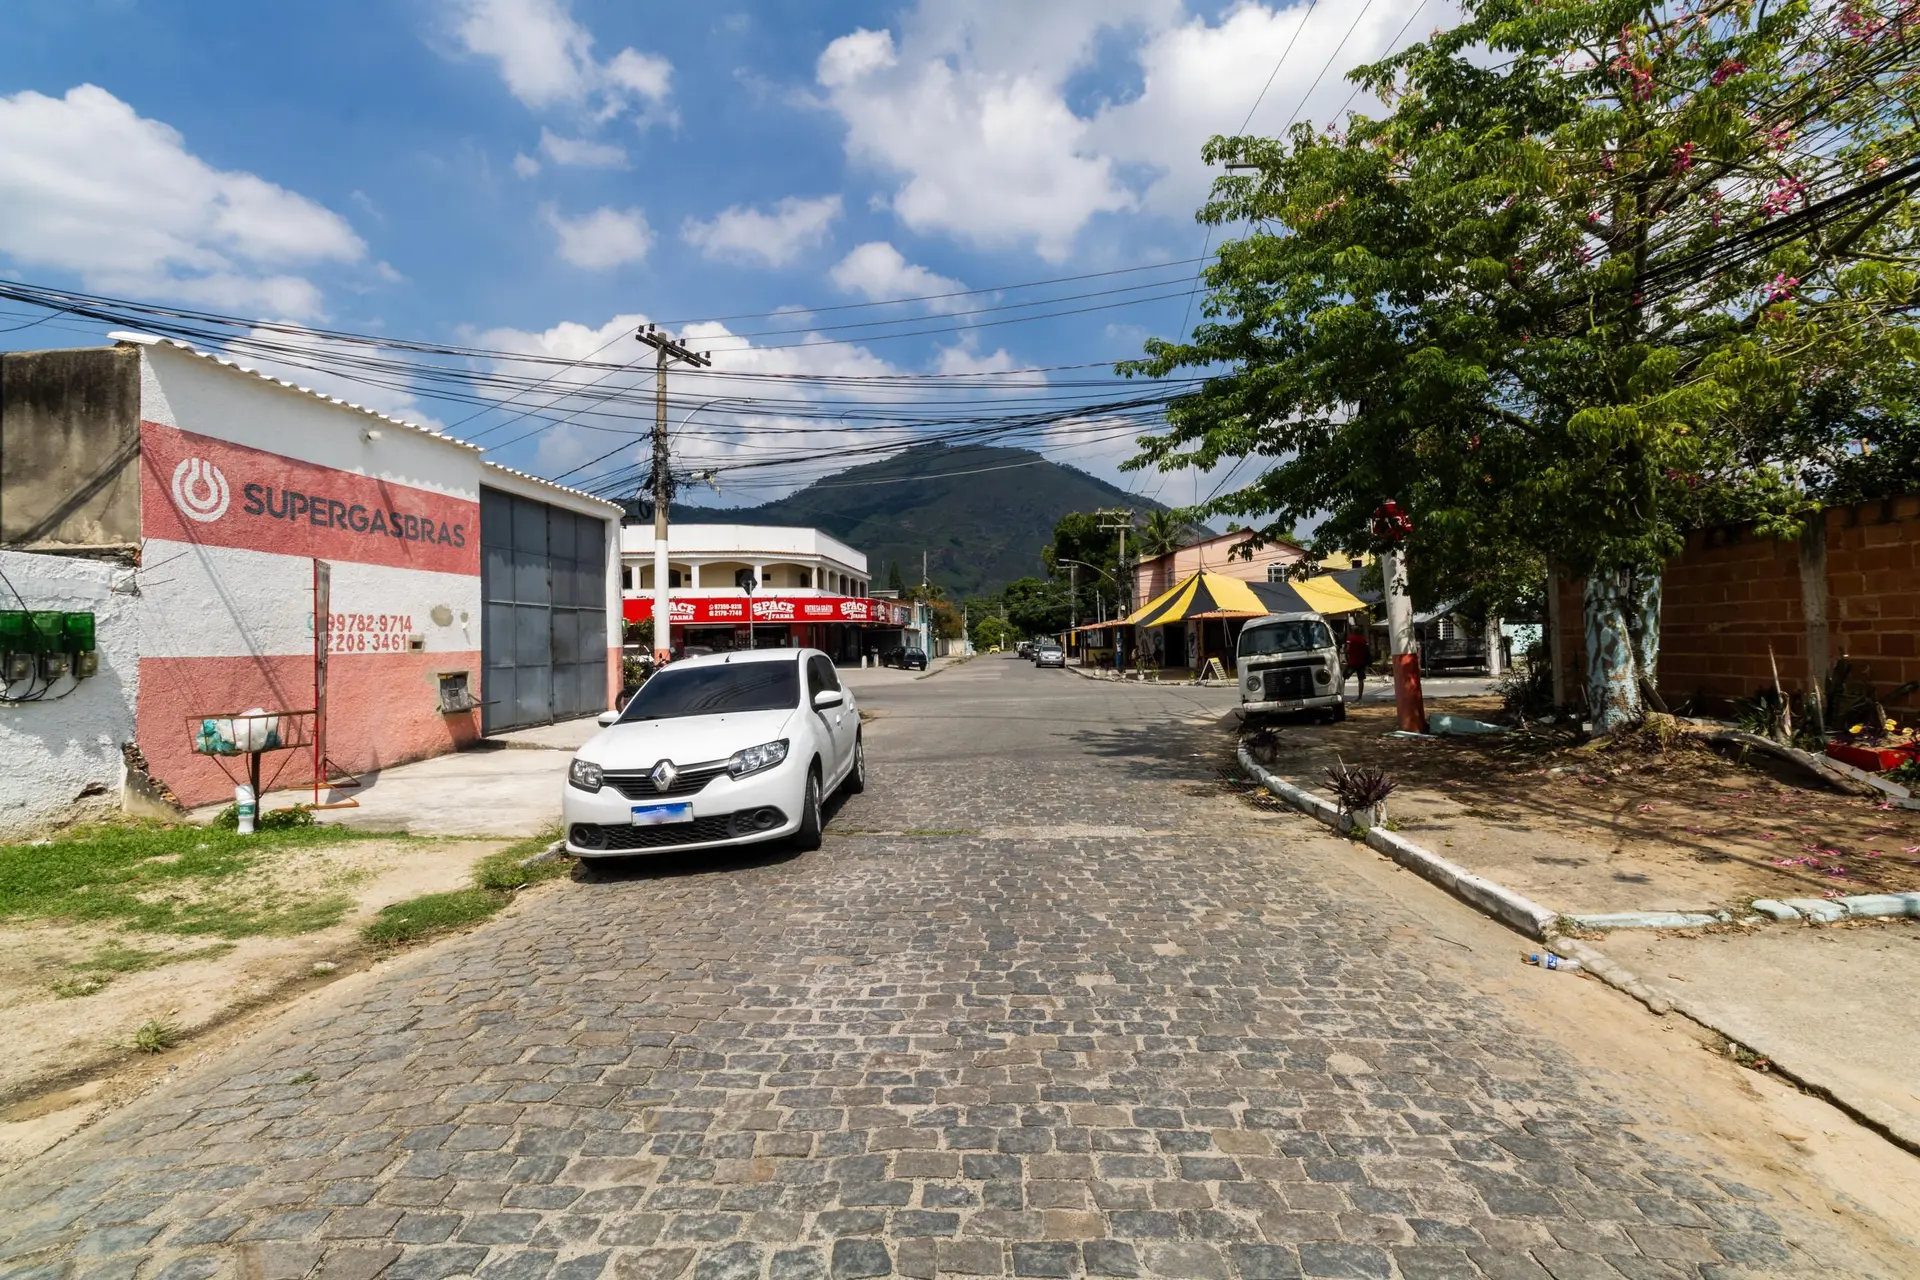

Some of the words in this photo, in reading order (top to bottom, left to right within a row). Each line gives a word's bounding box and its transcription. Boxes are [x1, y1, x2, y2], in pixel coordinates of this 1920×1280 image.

[243, 483, 466, 548] SUPERGASBRAS
[752, 600, 795, 613] SPACE
[840, 601, 868, 613] SPACE
